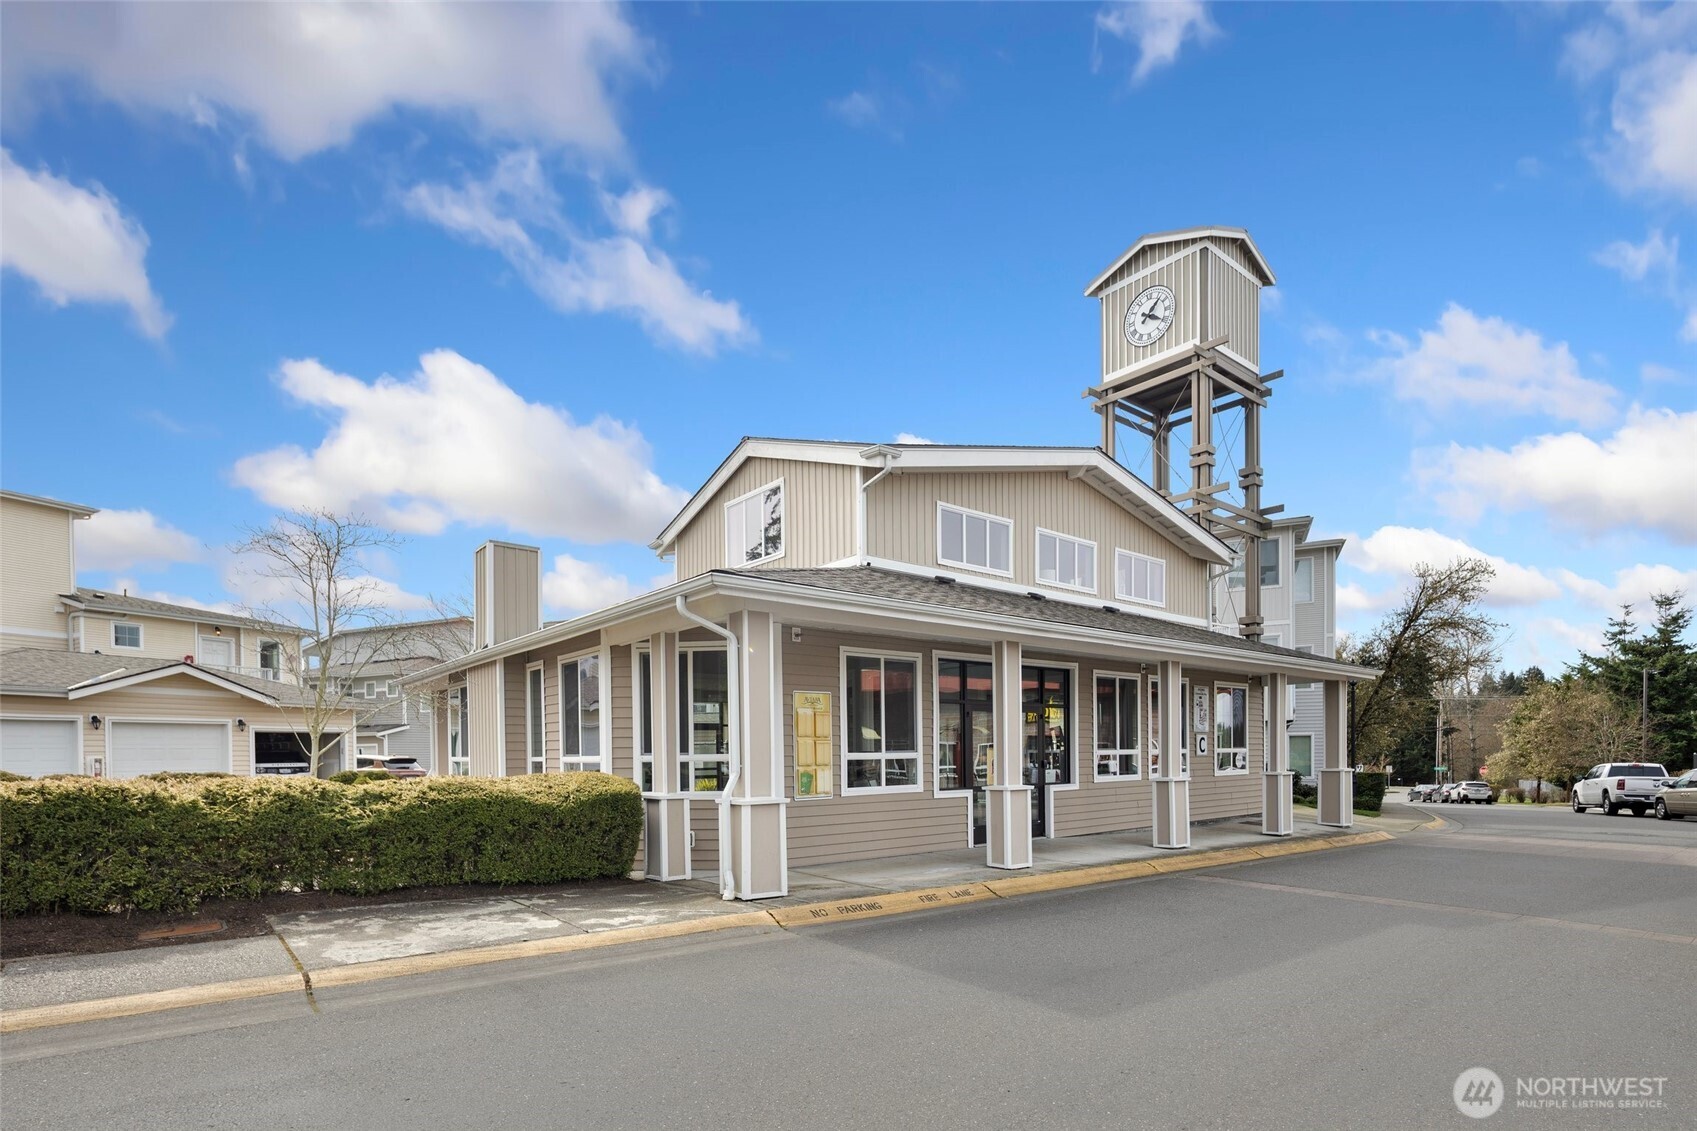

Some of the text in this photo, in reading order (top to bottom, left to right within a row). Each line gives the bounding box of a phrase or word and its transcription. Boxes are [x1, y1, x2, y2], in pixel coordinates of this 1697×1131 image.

[1199, 736, 1206, 753] C
[918, 889, 974, 903] FIRE LANE
[809, 901, 883, 918] NO PARKING
